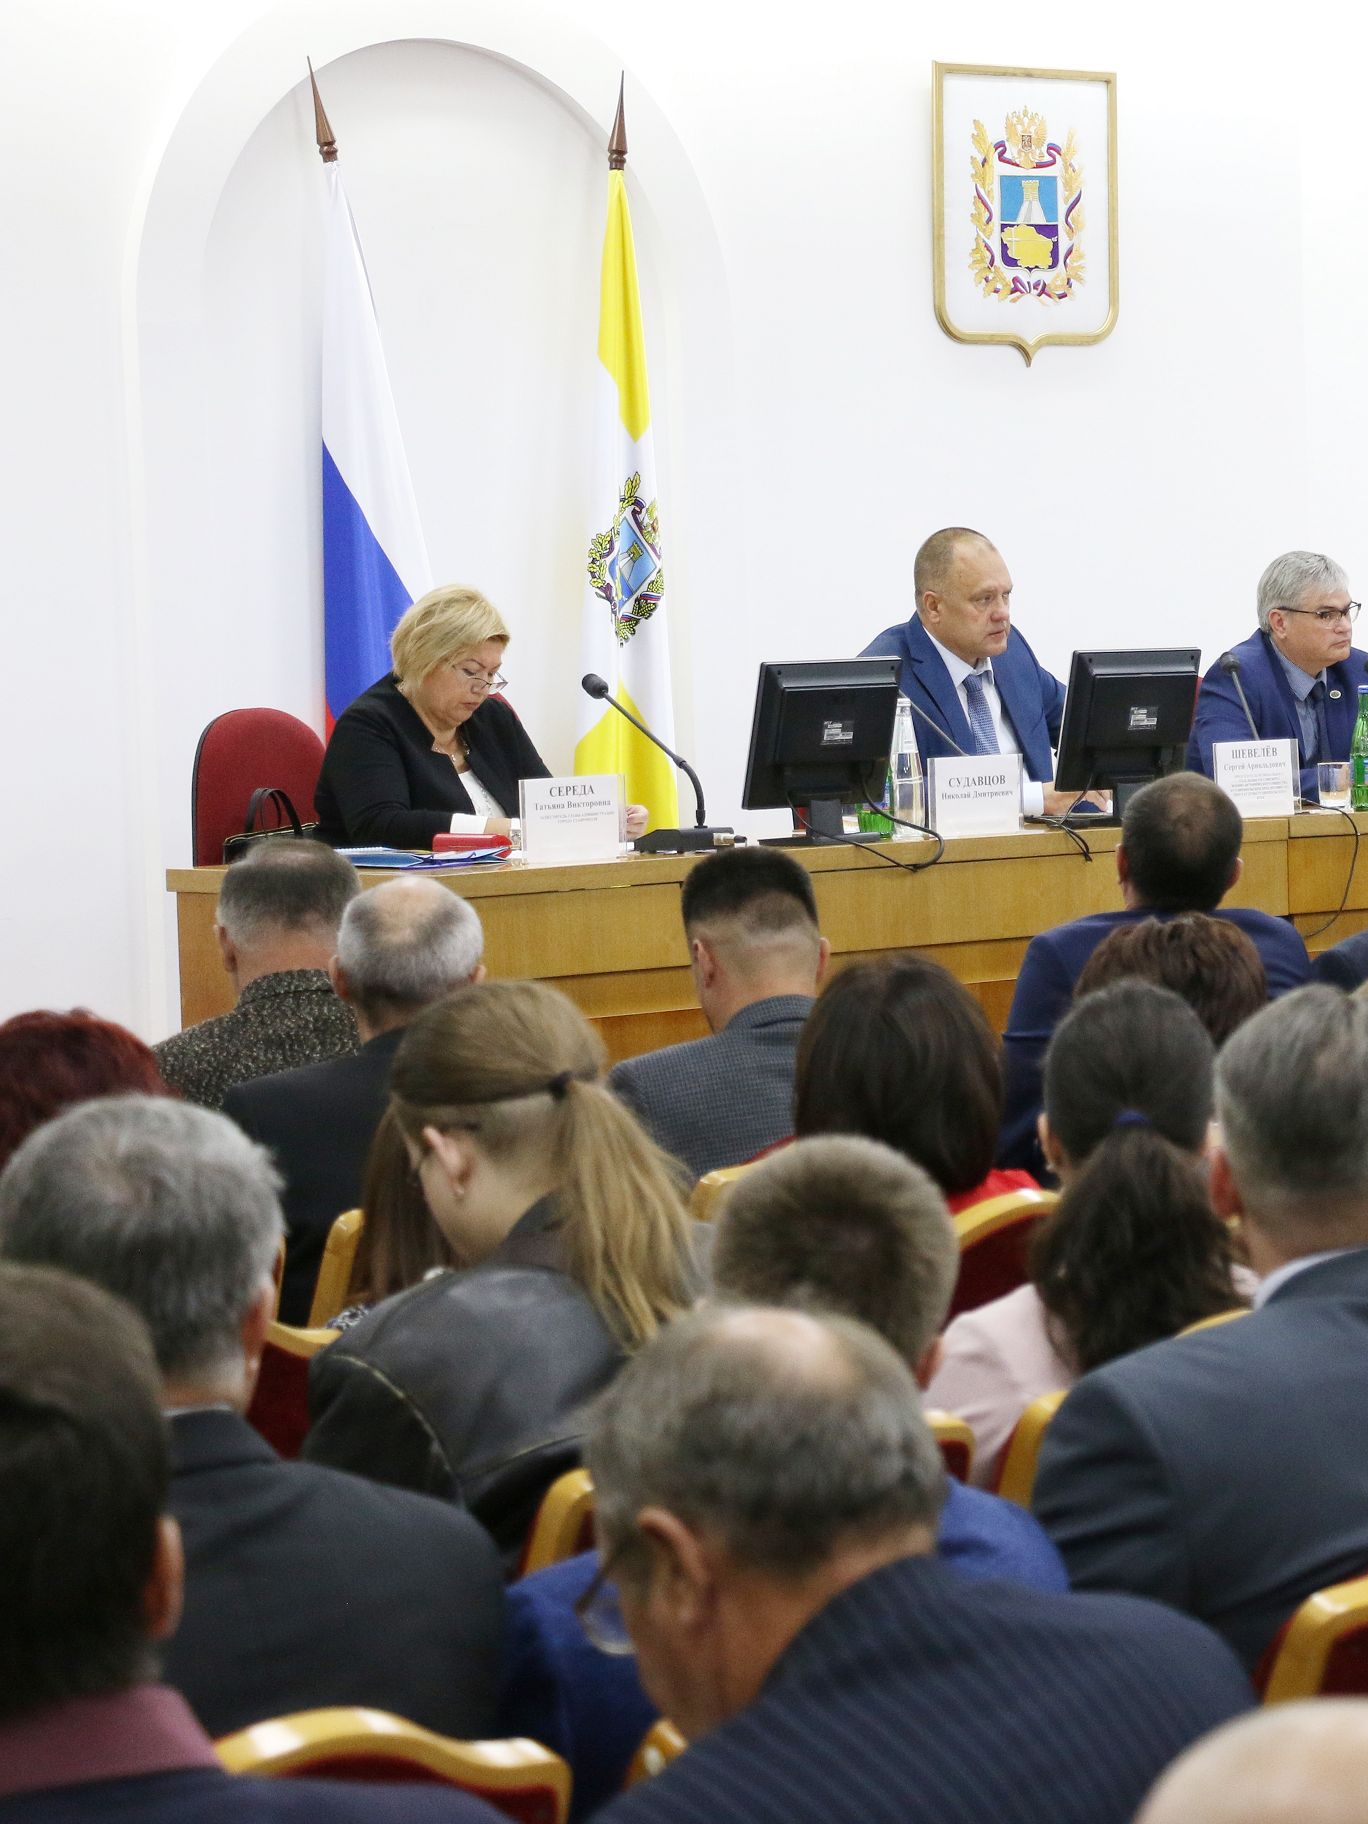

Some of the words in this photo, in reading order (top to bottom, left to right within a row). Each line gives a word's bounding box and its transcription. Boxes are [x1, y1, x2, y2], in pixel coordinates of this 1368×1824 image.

[1231, 745, 1278, 759] ШЕВЕЛЁВ
[948, 774, 1006, 788] СУДАВЦОВ
[549, 784, 594, 797] СЕРЕДА
[941, 791, 971, 800] Николай
[972, 789, 1013, 799] Дмитриевич
[535, 801, 565, 811] Татьяна
[567, 800, 611, 809] Викторовна
